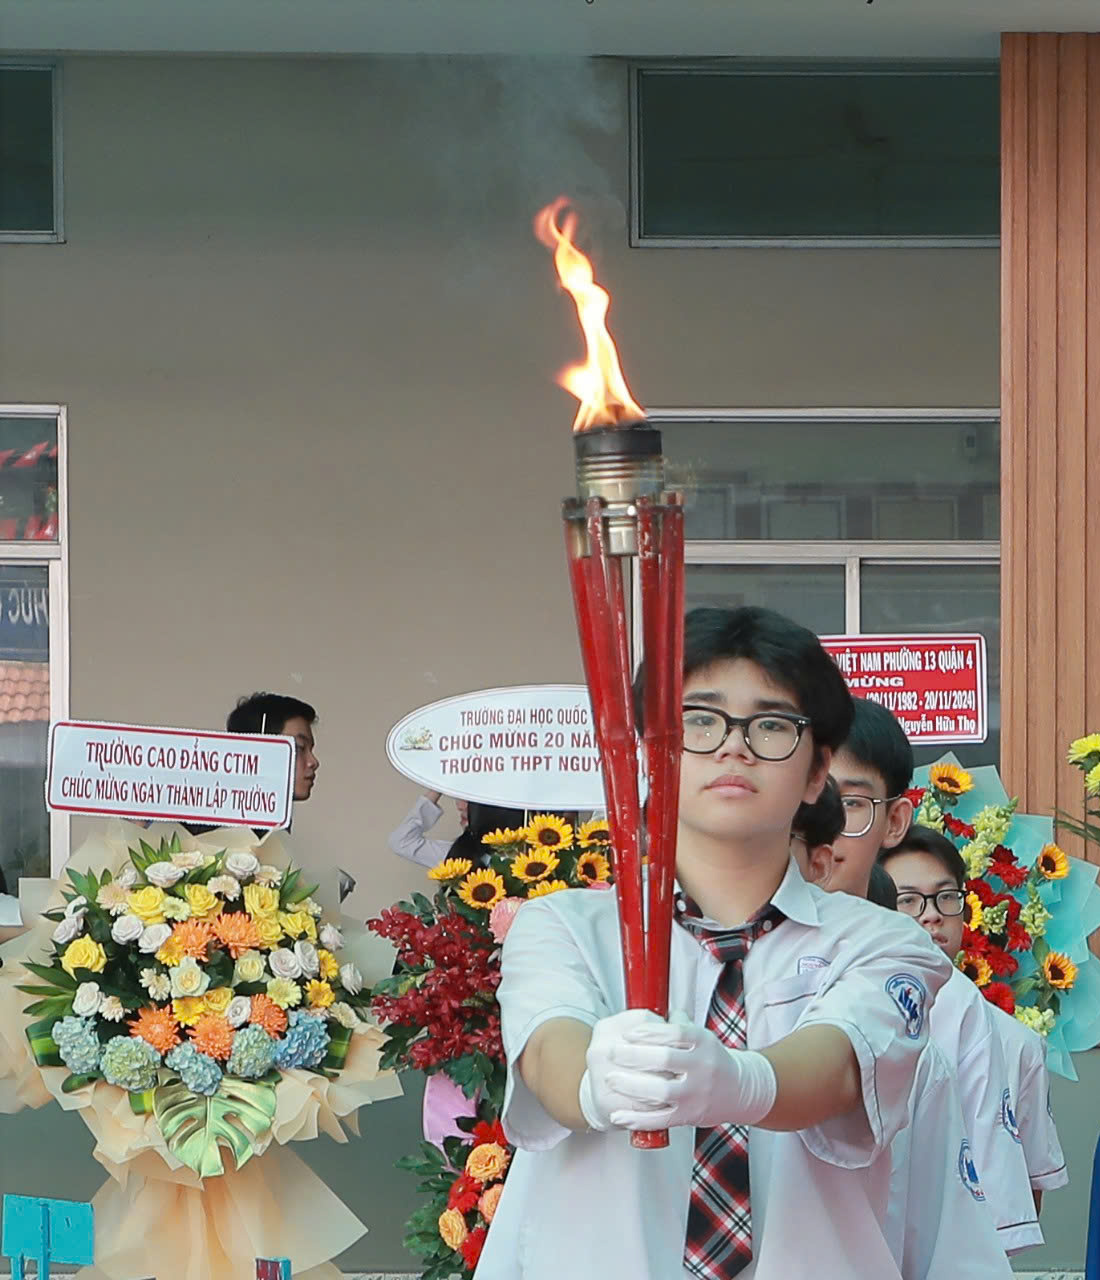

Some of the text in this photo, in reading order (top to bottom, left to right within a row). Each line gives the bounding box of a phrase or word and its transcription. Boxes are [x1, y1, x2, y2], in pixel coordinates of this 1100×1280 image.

[859, 651, 882, 673] NAM
[883, 646, 922, 672] PHƯỜNG
[924, 650, 937, 671] 13
[938, 645, 965, 674] QUẬN
[966, 650, 973, 669] 4
[924, 689, 976, 711] 20/11/2024)
[460, 703, 588, 729] TRƯỜNG ĐẠI HỌC QUỐC
[897, 713, 976, 735] Nguyễn Hữu Thọ
[438, 725, 600, 752] CHÚC MỪNG 20 NĂ
[86, 736, 259, 775] TRƯỜNG CAO ĐẲNG CTIM
[439, 754, 602, 775] TRƯỜNG THPT NGUY
[61, 770, 277, 818] CHÚC MỪNG NGÀY THÀNH LẬP TRƯỜNG
